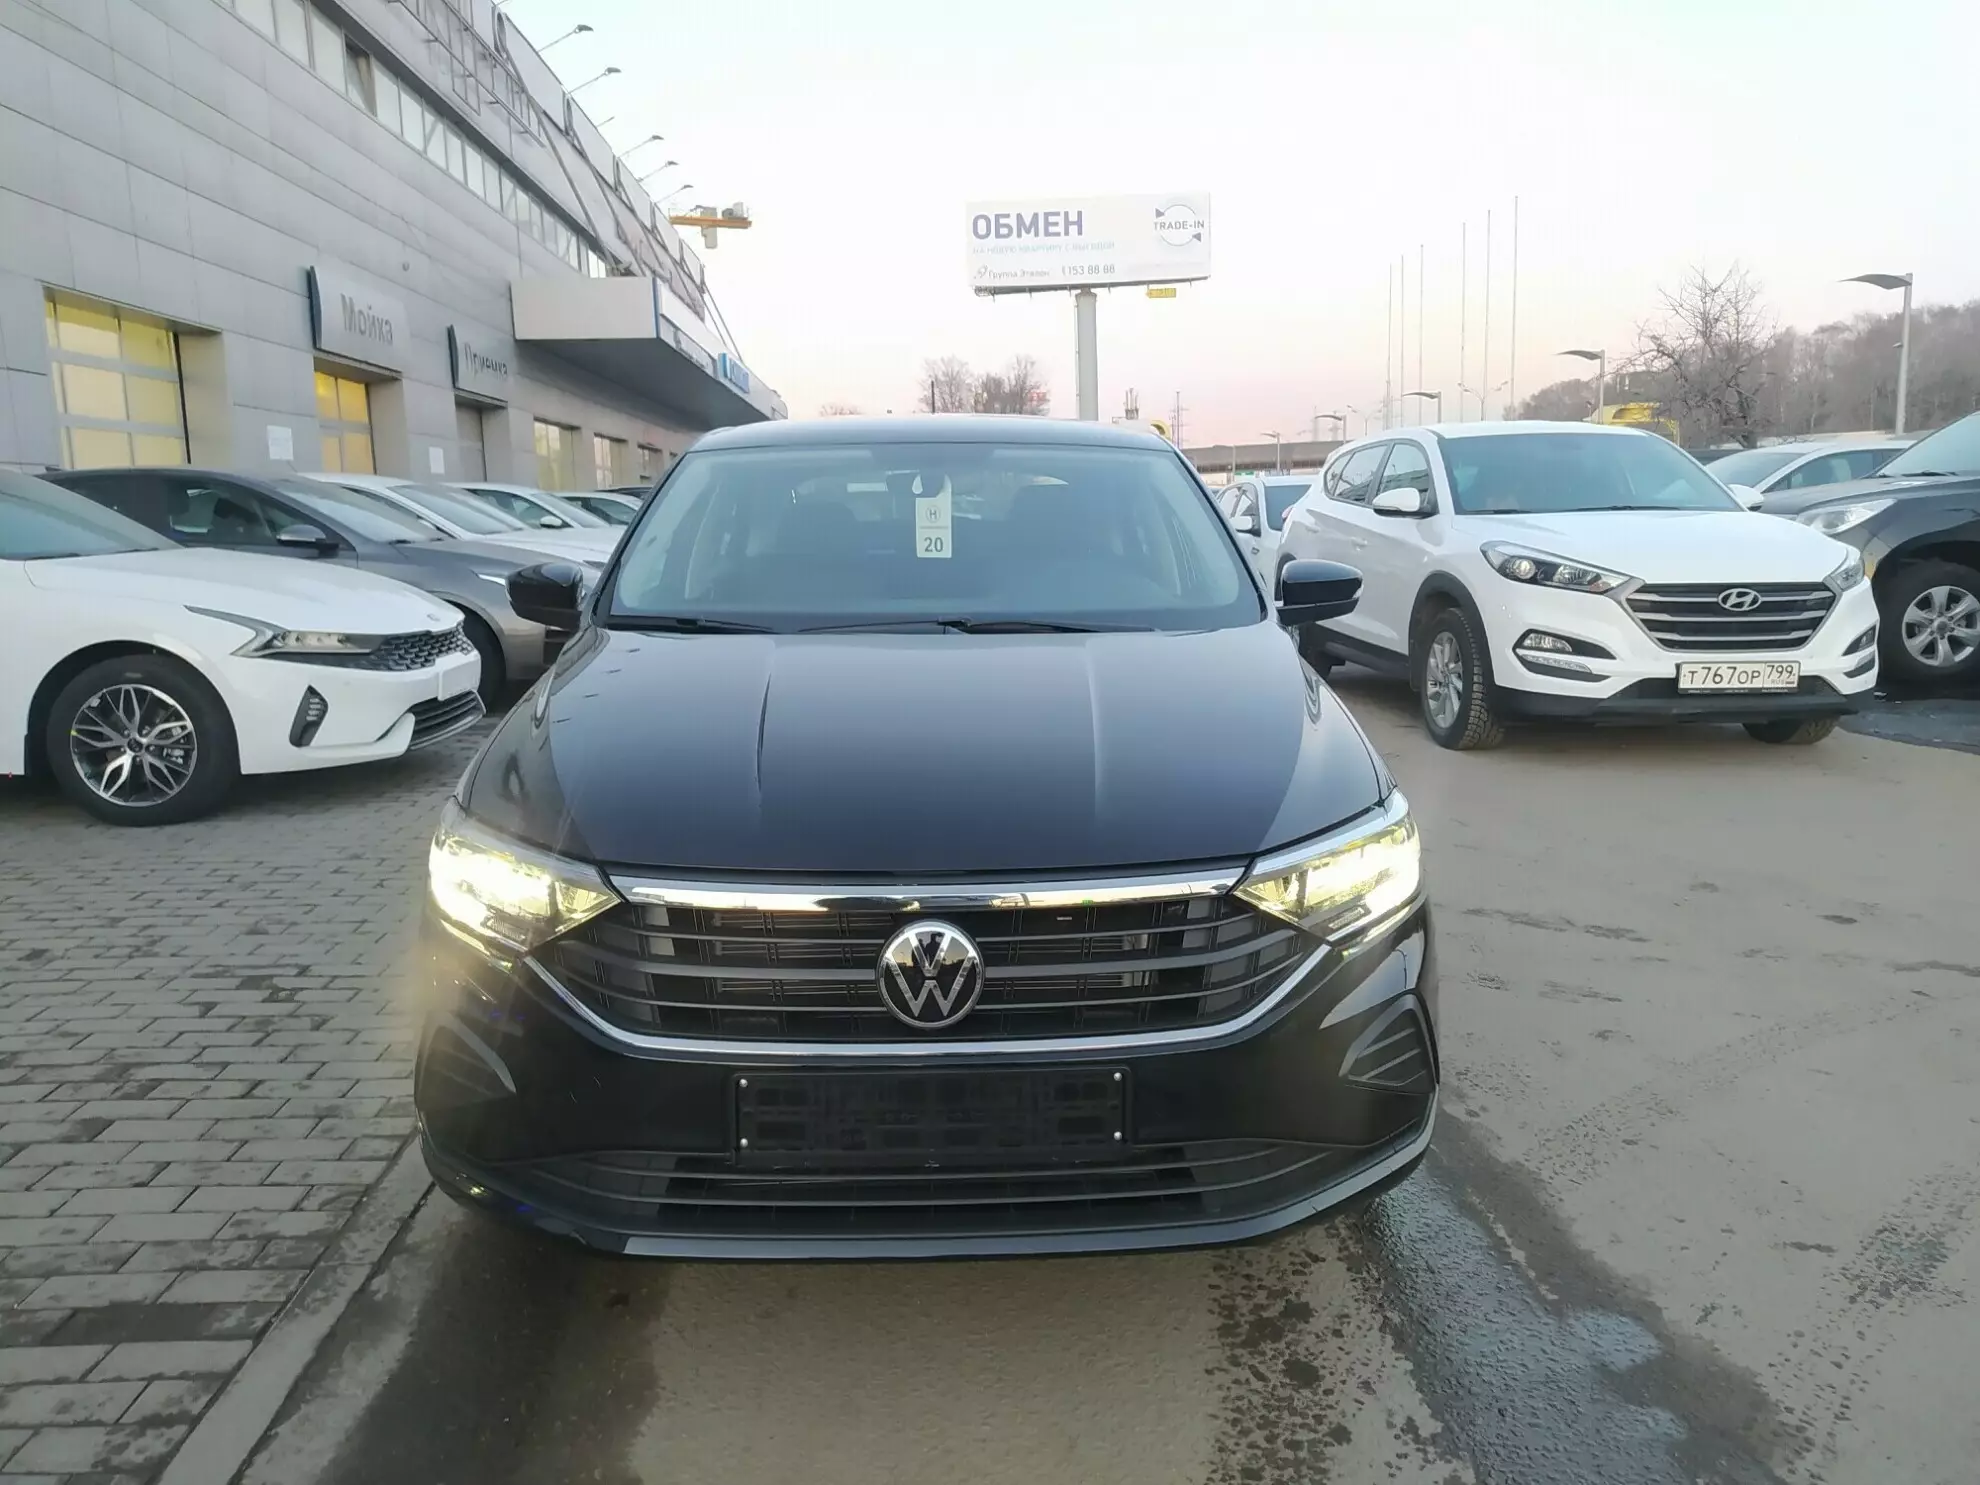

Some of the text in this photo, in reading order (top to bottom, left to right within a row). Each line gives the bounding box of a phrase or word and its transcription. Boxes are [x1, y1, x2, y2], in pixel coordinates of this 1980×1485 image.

[972, 210, 1083, 239] ОБМЕН
[1153, 220, 1205, 231] TRADE-IN
[988, 269, 1018, 280] Группа
[340, 293, 394, 346] Мойка
[924, 537, 944, 553] 20
[1767, 664, 1794, 679] 799
